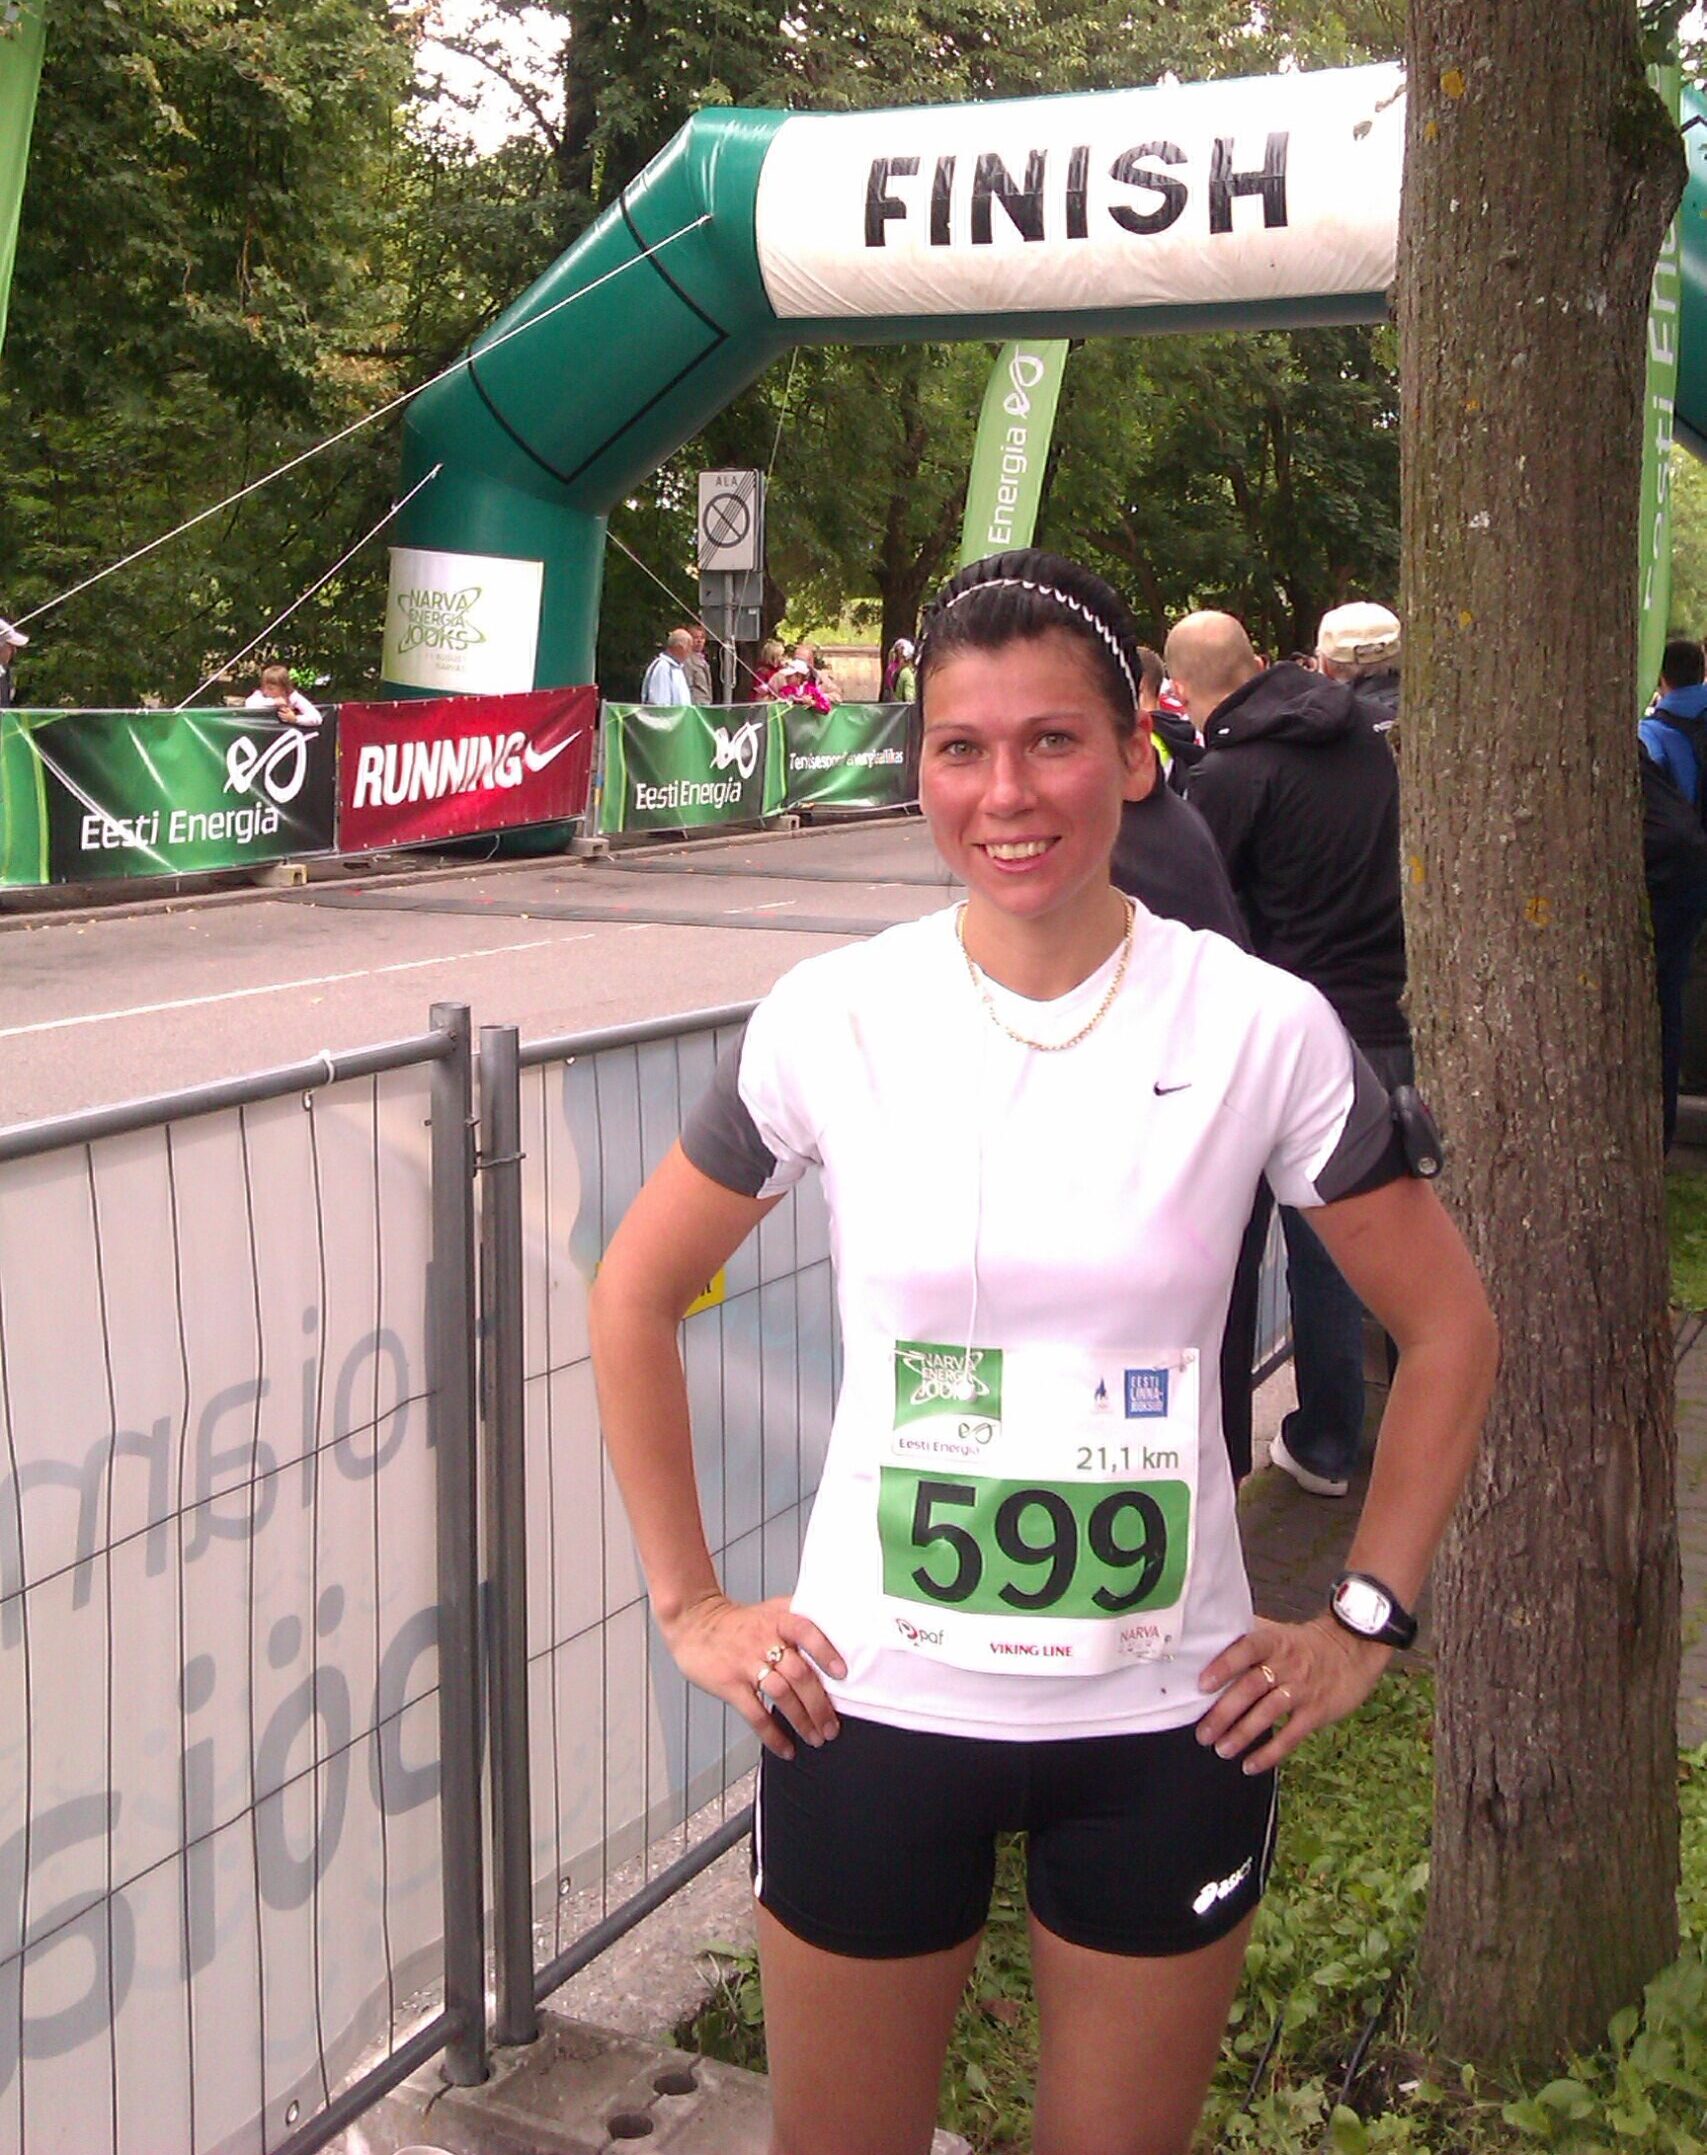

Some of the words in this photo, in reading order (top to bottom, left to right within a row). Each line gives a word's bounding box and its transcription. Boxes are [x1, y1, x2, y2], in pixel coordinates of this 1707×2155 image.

[865, 131, 1289, 247] FINISH
[715, 476, 739, 487] ALA
[988, 427, 1027, 545] Energia
[409, 588, 470, 612] NARVA
[408, 608, 466, 628] ENERGIA
[405, 624, 469, 651] JOOKS
[352, 731, 526, 808] RUNNING
[636, 780, 678, 809] Eesti
[680, 776, 742, 809] Energia
[81, 810, 159, 850] Eesti
[169, 800, 279, 844] Energia
[899, 1438, 930, 1451] Eesti
[1077, 1446, 1129, 1473] 21,1
[1143, 1446, 1179, 1470] km
[911, 1480, 1167, 1612] 599
[919, 1629, 944, 1646] paf
[1119, 1625, 1160, 1643] NARVA
[990, 1643, 1039, 1656] VIKING
[1043, 1645, 1072, 1657] LINE
